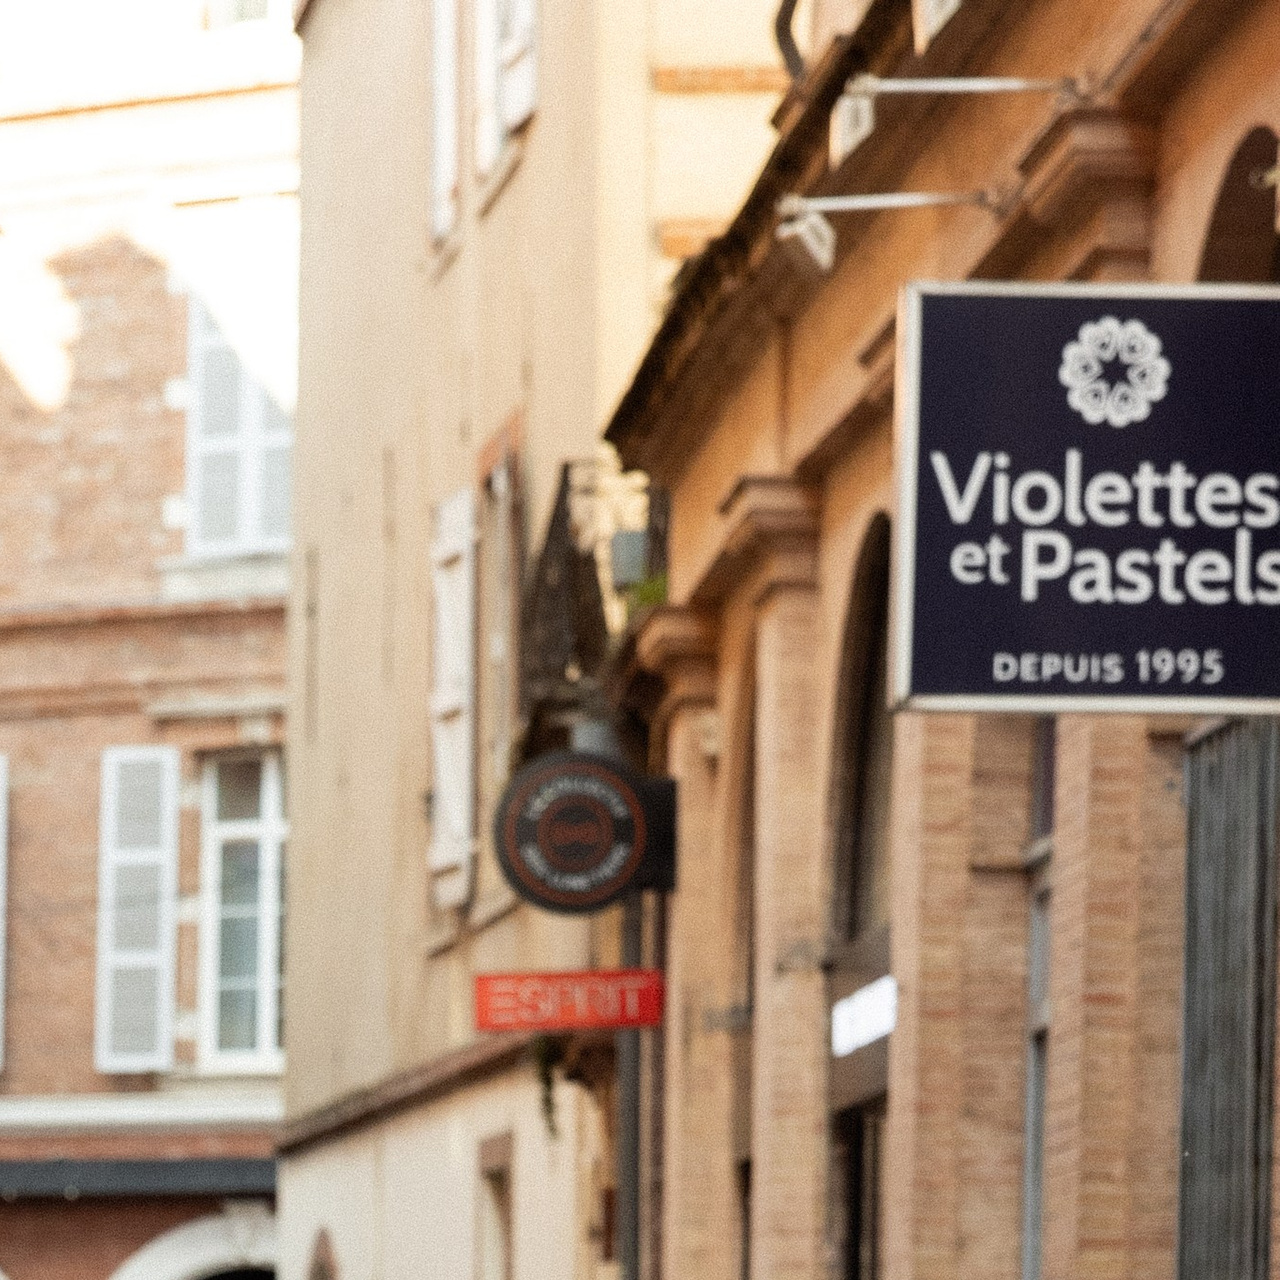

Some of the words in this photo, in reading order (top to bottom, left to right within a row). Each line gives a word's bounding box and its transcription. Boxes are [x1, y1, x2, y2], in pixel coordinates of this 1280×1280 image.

[930, 448, 1280, 528] Violettes
[950, 534, 1011, 585] et
[1022, 528, 1280, 605] Pastels
[992, 651, 1125, 683] DEPUIS
[1136, 648, 1225, 684] 1995
[490, 976, 647, 1024] ESPRIT
